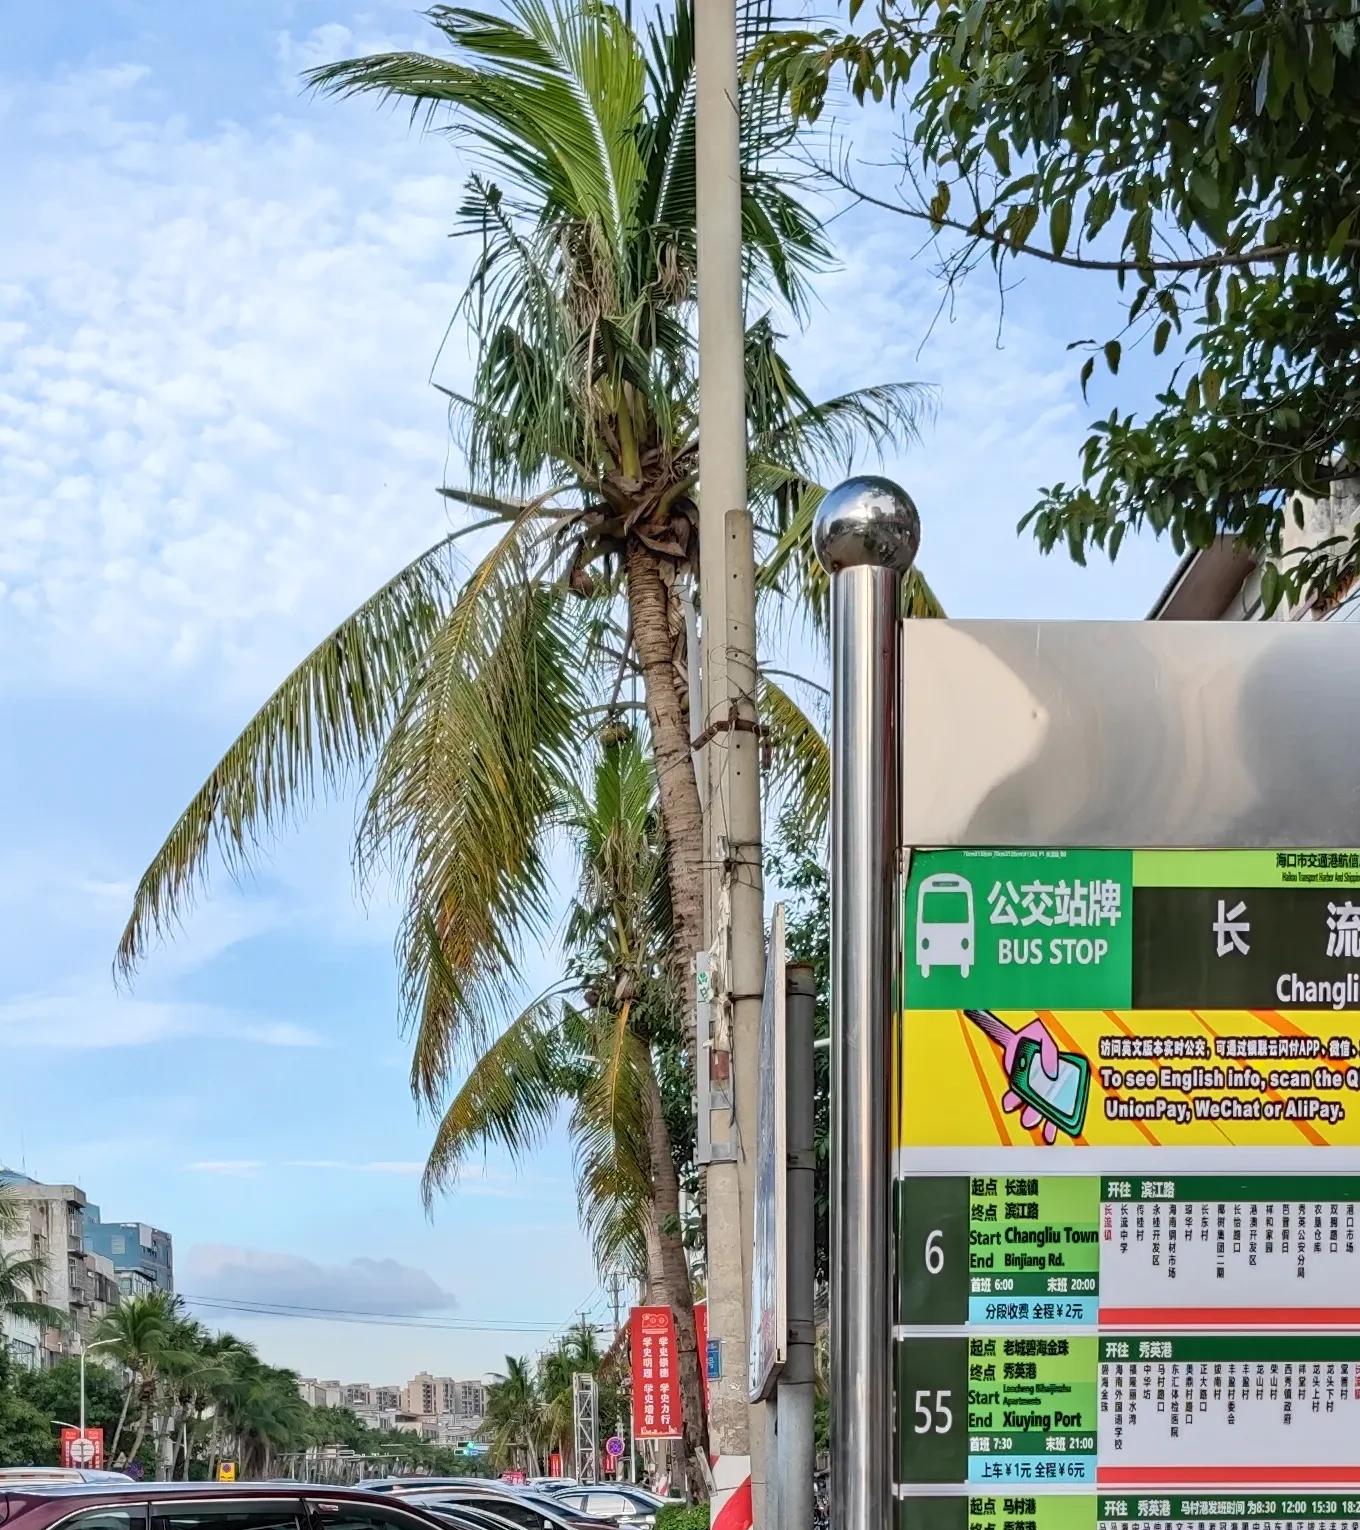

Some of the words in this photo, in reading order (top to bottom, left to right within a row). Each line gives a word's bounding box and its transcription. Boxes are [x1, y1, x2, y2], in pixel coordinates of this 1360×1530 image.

[987, 879, 1121, 927] 公交站牌
[999, 939, 1042, 965] BUS
[1050, 939, 1107, 965] STOP
[1102, 1069, 1122, 1087] To
[1126, 1072, 1155, 1087] see
[1160, 1070, 1224, 1092] English
[1228, 1070, 1267, 1092] info,
[1270, 1073, 1310, 1087] scan
[1315, 1069, 1342, 1087] the
[1106, 1100, 1191, 1122] UnionPay,
[1194, 1099, 1260, 1118] WeChat
[1263, 1103, 1283, 1118] or
[1285, 1099, 1345, 1121] AliPay.
[971, 1178, 997, 1196] 起点
[1005, 1178, 1039, 1196] 长流镇
[1108, 1182, 1131, 1198] 开往
[1141, 1182, 1174, 1198] 滨江路
[971, 1203, 997, 1221] 终点
[1005, 1202, 1039, 1219] 滨江路
[970, 1230, 1001, 1245] Start
[1005, 1227, 1061, 1245] Changliu
[1063, 1227, 1099, 1243] Town
[925, 1229, 944, 1274] 6
[970, 1254, 993, 1269] End
[1005, 1254, 1045, 1269] Binjiang
[1048, 1254, 1065, 1267] Rd.
[995, 1278, 1013, 1291] 6:00
[1071, 1278, 1095, 1291] 20:00
[986, 1304, 1028, 1319] 分段收费
[970, 1340, 996, 1357] 起点
[1106, 1342, 1129, 1358] 开往
[1139, 1342, 1172, 1358] 秀英港
[970, 1364, 996, 1381] 终点
[1003, 1362, 1037, 1379] 秀英港
[968, 1390, 999, 1405] Start
[914, 1390, 952, 1434] 55
[969, 1412, 992, 1428] End
[1003, 1411, 1051, 1431] Xiuying
[1054, 1411, 1081, 1427] Port
[993, 1438, 1012, 1450] 7:30
[1069, 1437, 1093, 1450] 21:00
[970, 1498, 996, 1515] 起点
[1003, 1498, 1036, 1515] 马村港
[1105, 1501, 1128, 1516] 开往
[1138, 1501, 1170, 1516] 秀英港
[1282, 1502, 1306, 1513] 12:00
[1312, 1502, 1337, 1513] 15:30
